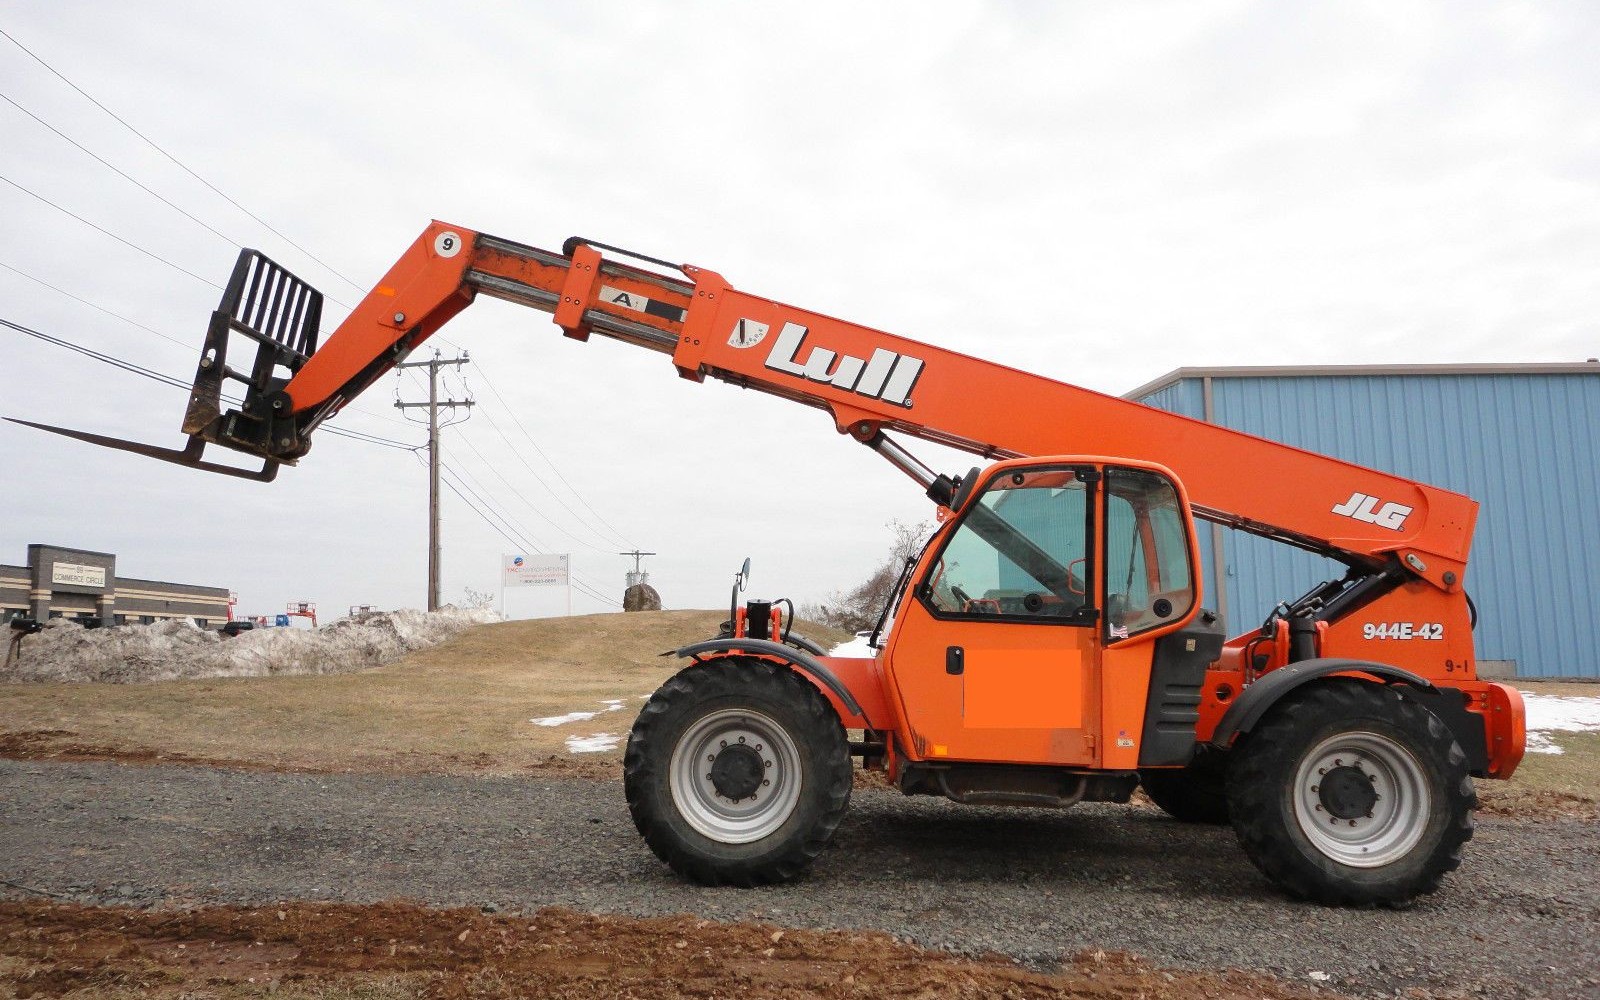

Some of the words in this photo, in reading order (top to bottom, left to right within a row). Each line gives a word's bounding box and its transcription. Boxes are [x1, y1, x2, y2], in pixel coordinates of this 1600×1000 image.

[442, 237, 454, 251] 9
[612, 292, 632, 308] A
[764, 321, 926, 409] Lull
[1330, 492, 1414, 531] JLG
[1363, 622, 1444, 640] 944E-42
